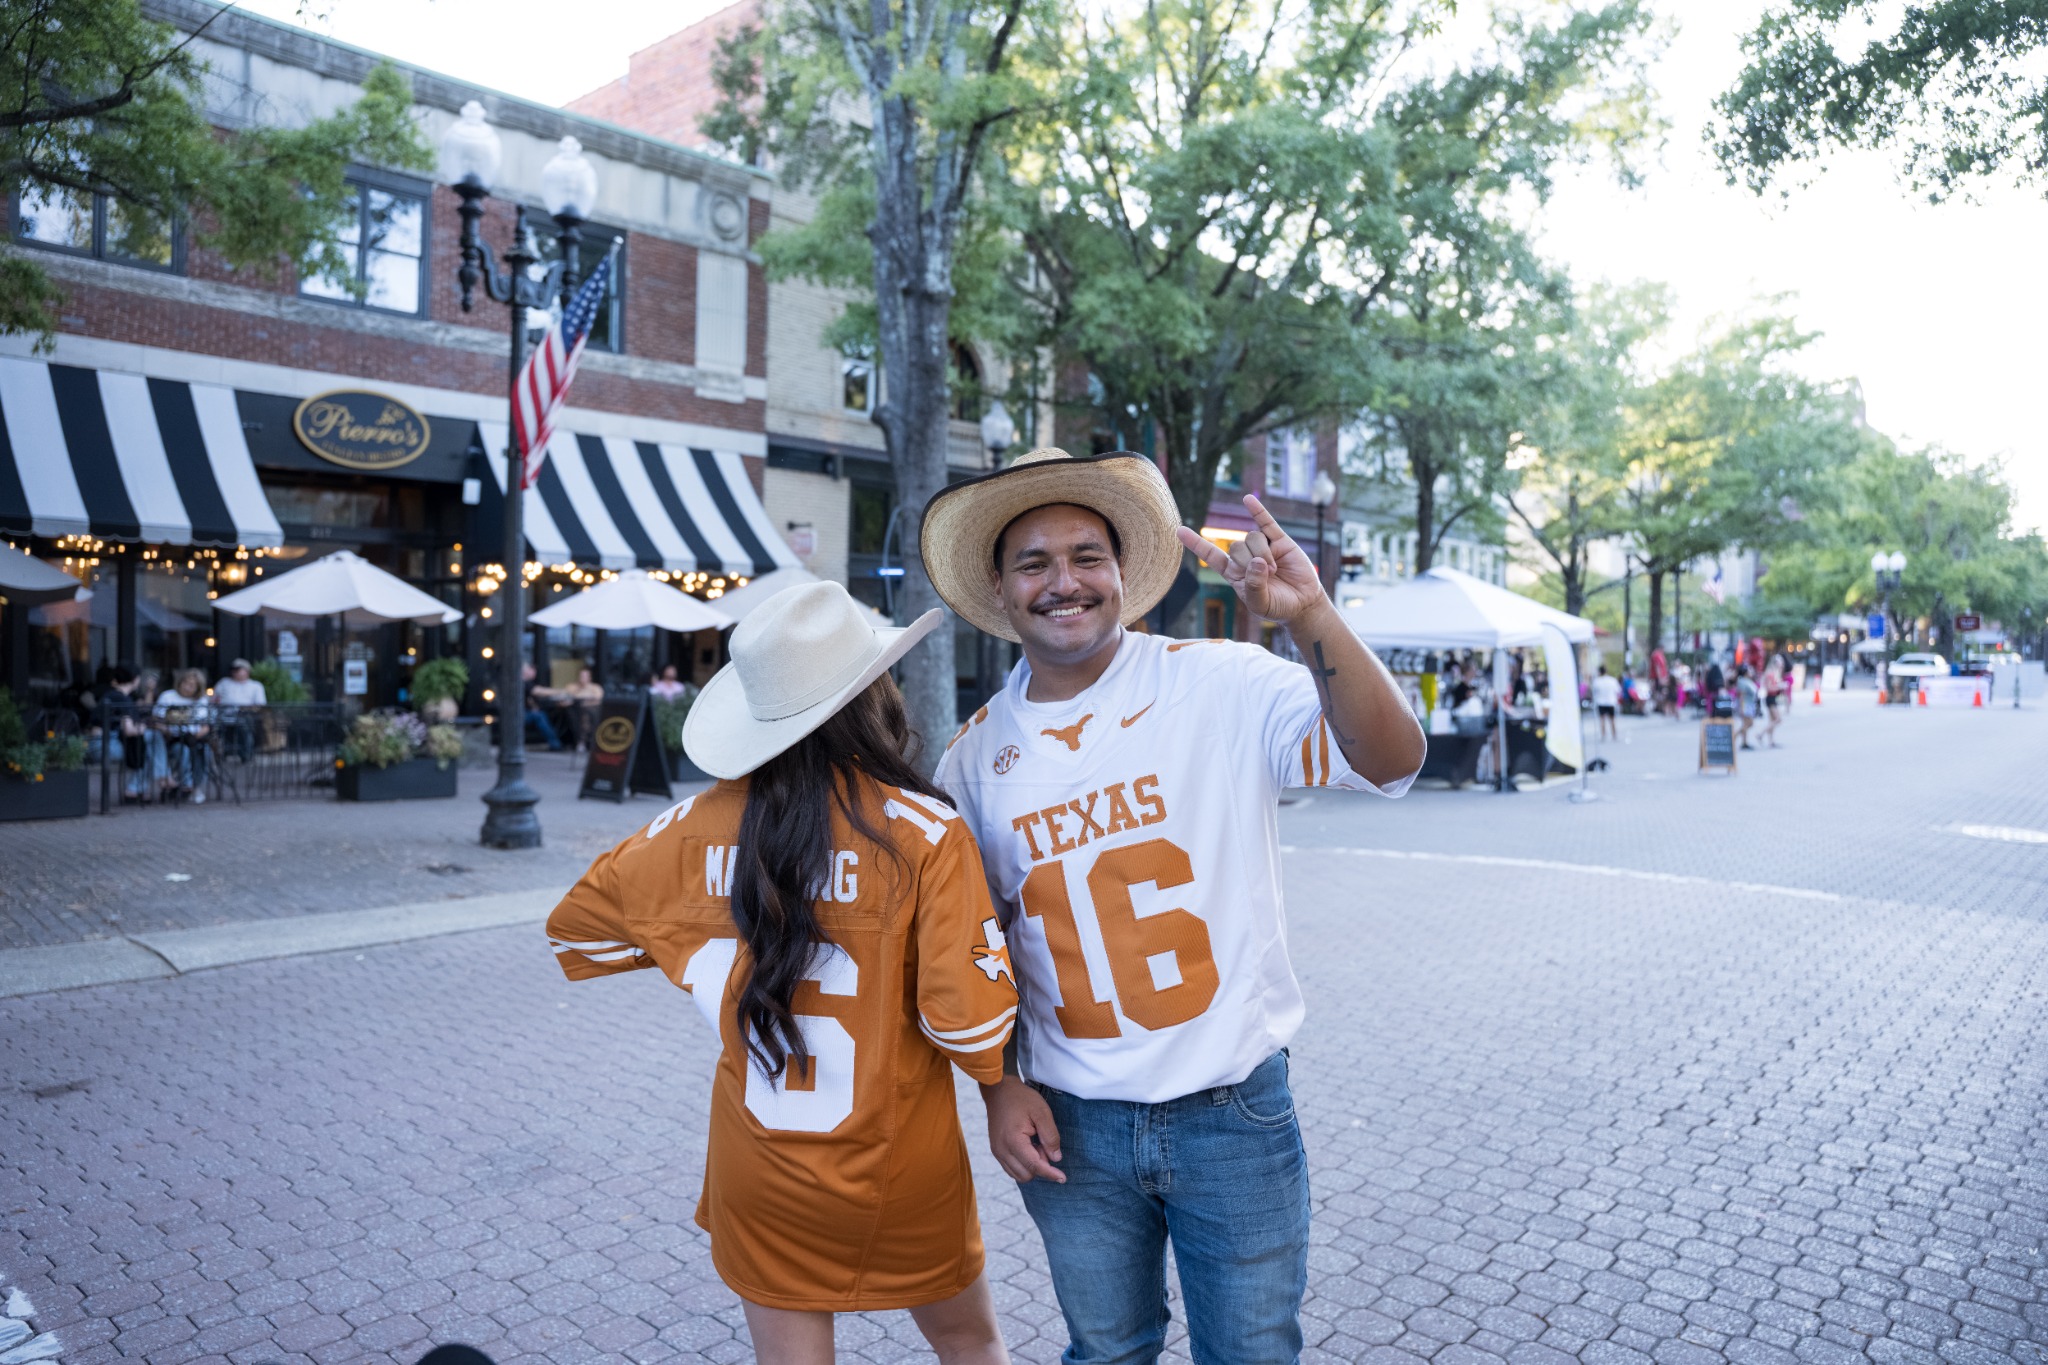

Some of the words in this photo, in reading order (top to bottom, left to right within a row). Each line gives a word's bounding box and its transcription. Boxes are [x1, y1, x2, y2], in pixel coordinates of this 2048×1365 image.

[307, 401, 419, 447] Pierro's
[1012, 774, 1168, 861] TEXAS
[1020, 837, 1221, 1039] 16
